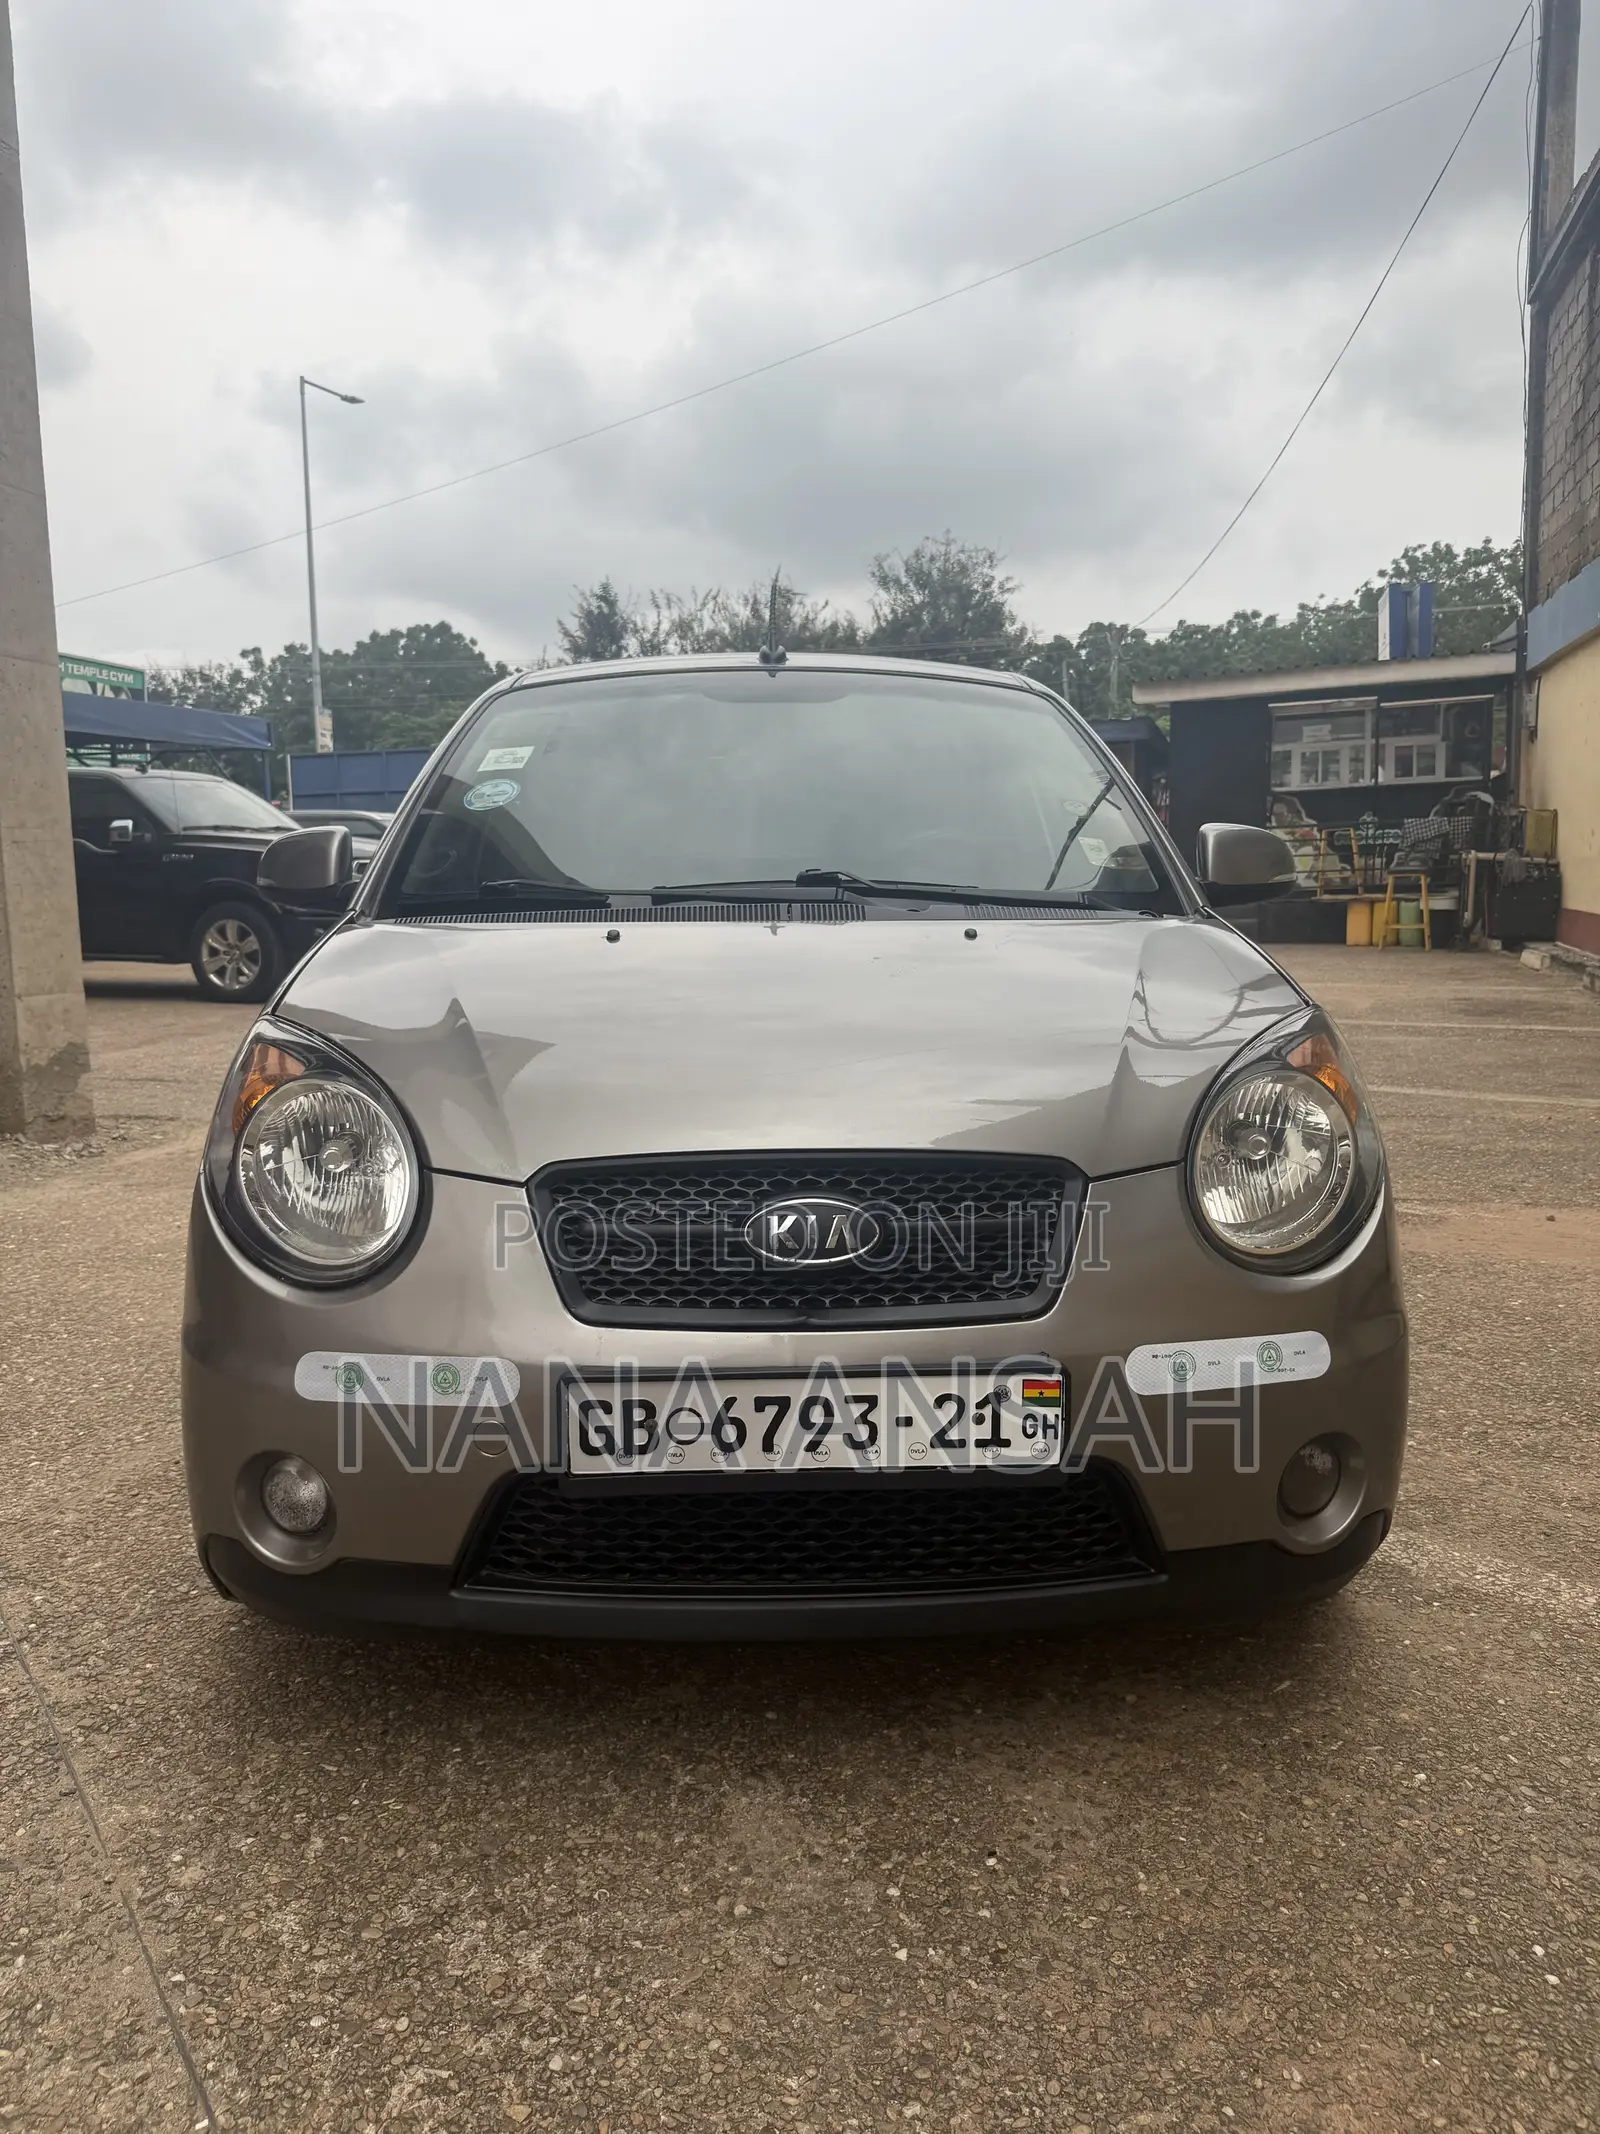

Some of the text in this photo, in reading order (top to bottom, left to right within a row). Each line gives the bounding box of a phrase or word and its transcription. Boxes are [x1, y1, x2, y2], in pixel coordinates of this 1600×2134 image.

[67, 663, 109, 679] TEMPLE
[110, 671, 134, 683] GYM
[767, 1215, 858, 1249] KIA
[579, 1399, 660, 1456] GB
[1022, 1413, 1060, 1440] GH
